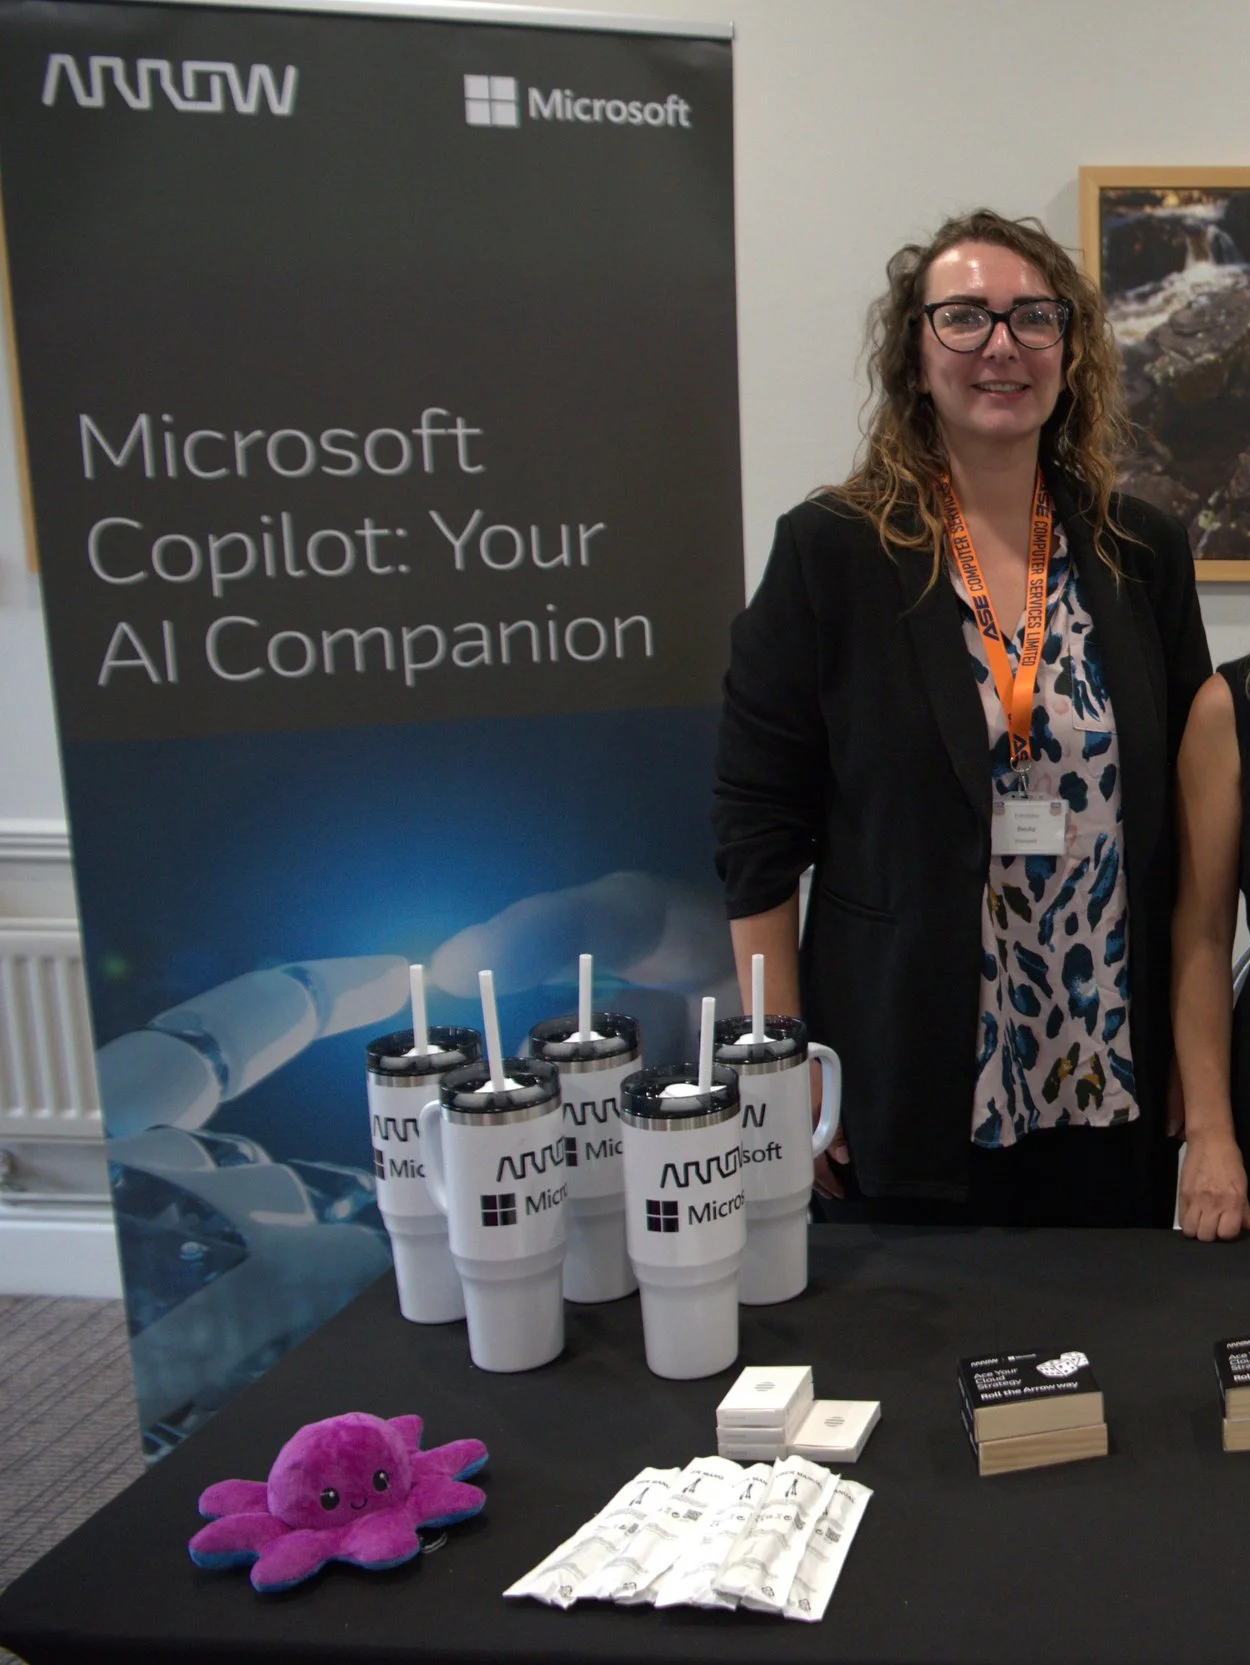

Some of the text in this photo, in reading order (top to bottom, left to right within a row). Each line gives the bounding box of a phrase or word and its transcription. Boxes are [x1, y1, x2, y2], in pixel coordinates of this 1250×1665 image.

[42, 53, 297, 115] ARROW
[528, 87, 692, 128] Microsoft
[79, 407, 485, 479] Microsoft
[87, 508, 606, 597] Copilot: Your
[954, 535, 984, 592] COMPUTER
[1031, 520, 1048, 576] COMPUTER
[973, 594, 1000, 641] ASE
[1028, 579, 1043, 629] SERVICES
[98, 603, 655, 688] AI Companion
[1022, 632, 1040, 667] LIMITED
[1013, 734, 1028, 763] AS
[660, 1141, 744, 1188] ARRO
[974, 1372, 993, 1380] Ace
[975, 1375, 1006, 1384] Cloud
[977, 1379, 1022, 1390] Strategy
[980, 1381, 1078, 1401] Roll the Arrow way
